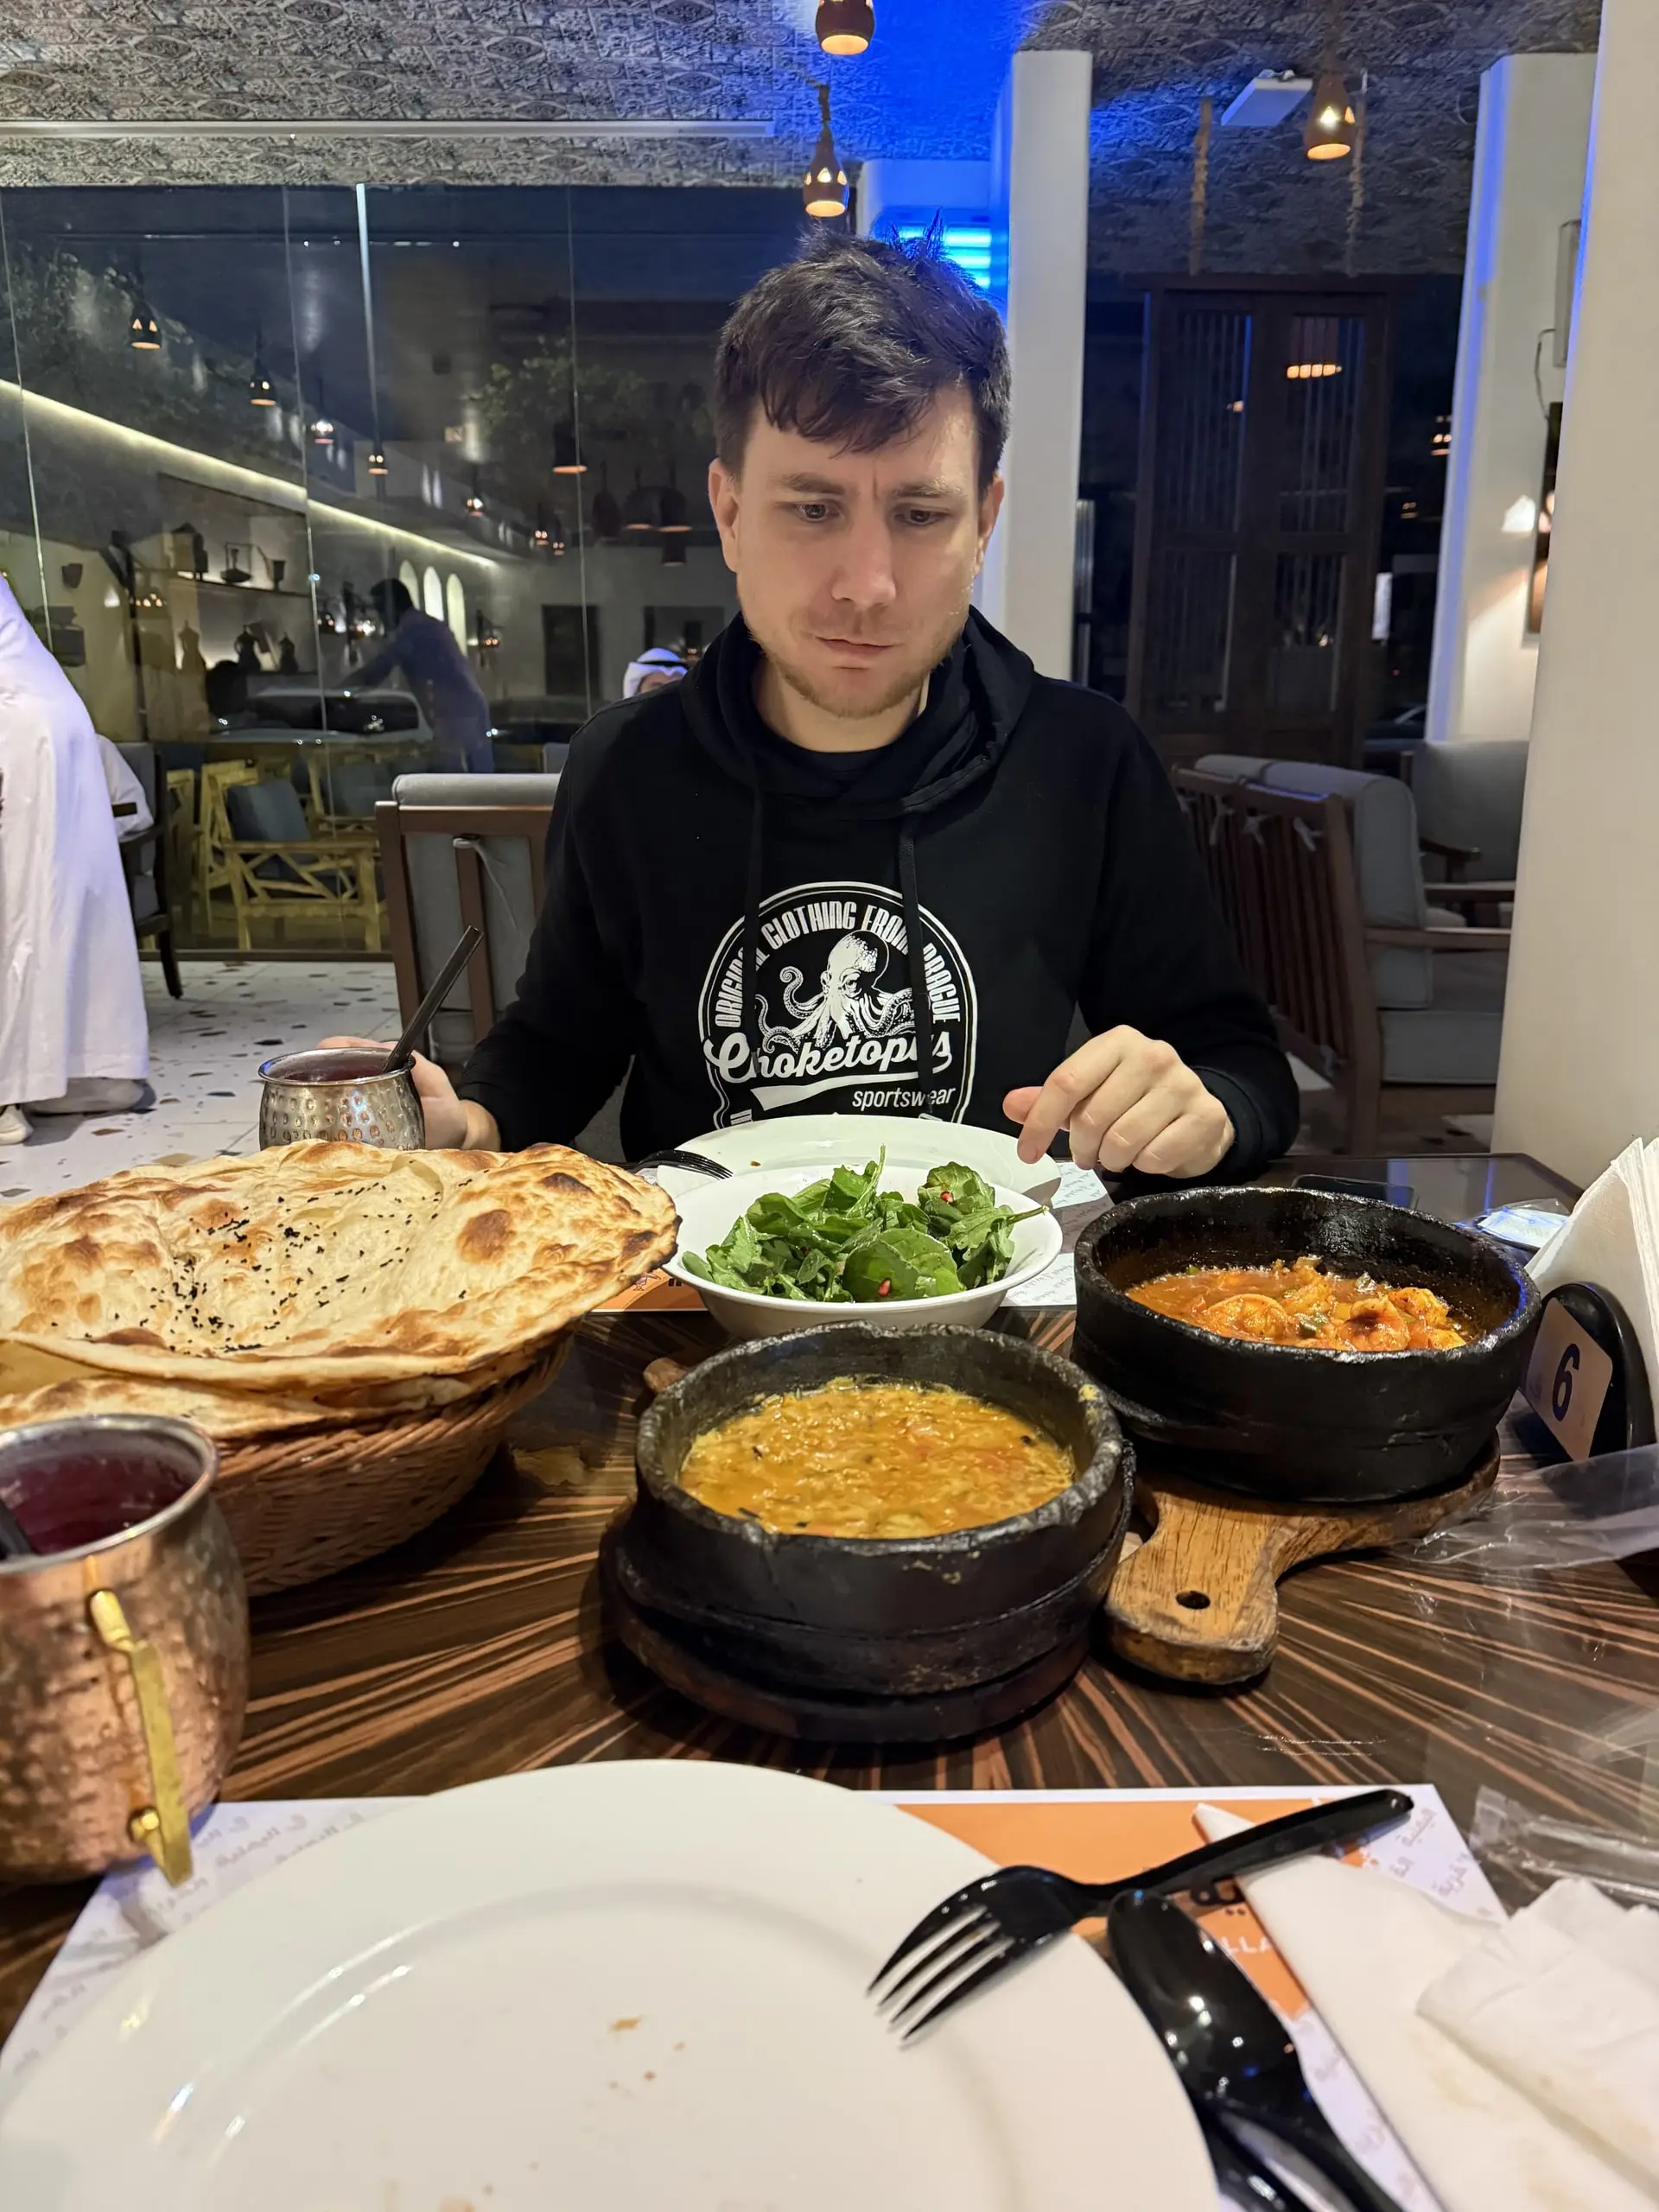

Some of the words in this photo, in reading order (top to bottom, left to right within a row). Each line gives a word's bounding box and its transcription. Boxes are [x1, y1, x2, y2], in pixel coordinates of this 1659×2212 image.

[760, 901, 857, 950] CLOTHING
[922, 942, 961, 1025] PRAGUE
[851, 1086, 957, 1112] sportswear
[1552, 1343, 1580, 1422] 6
